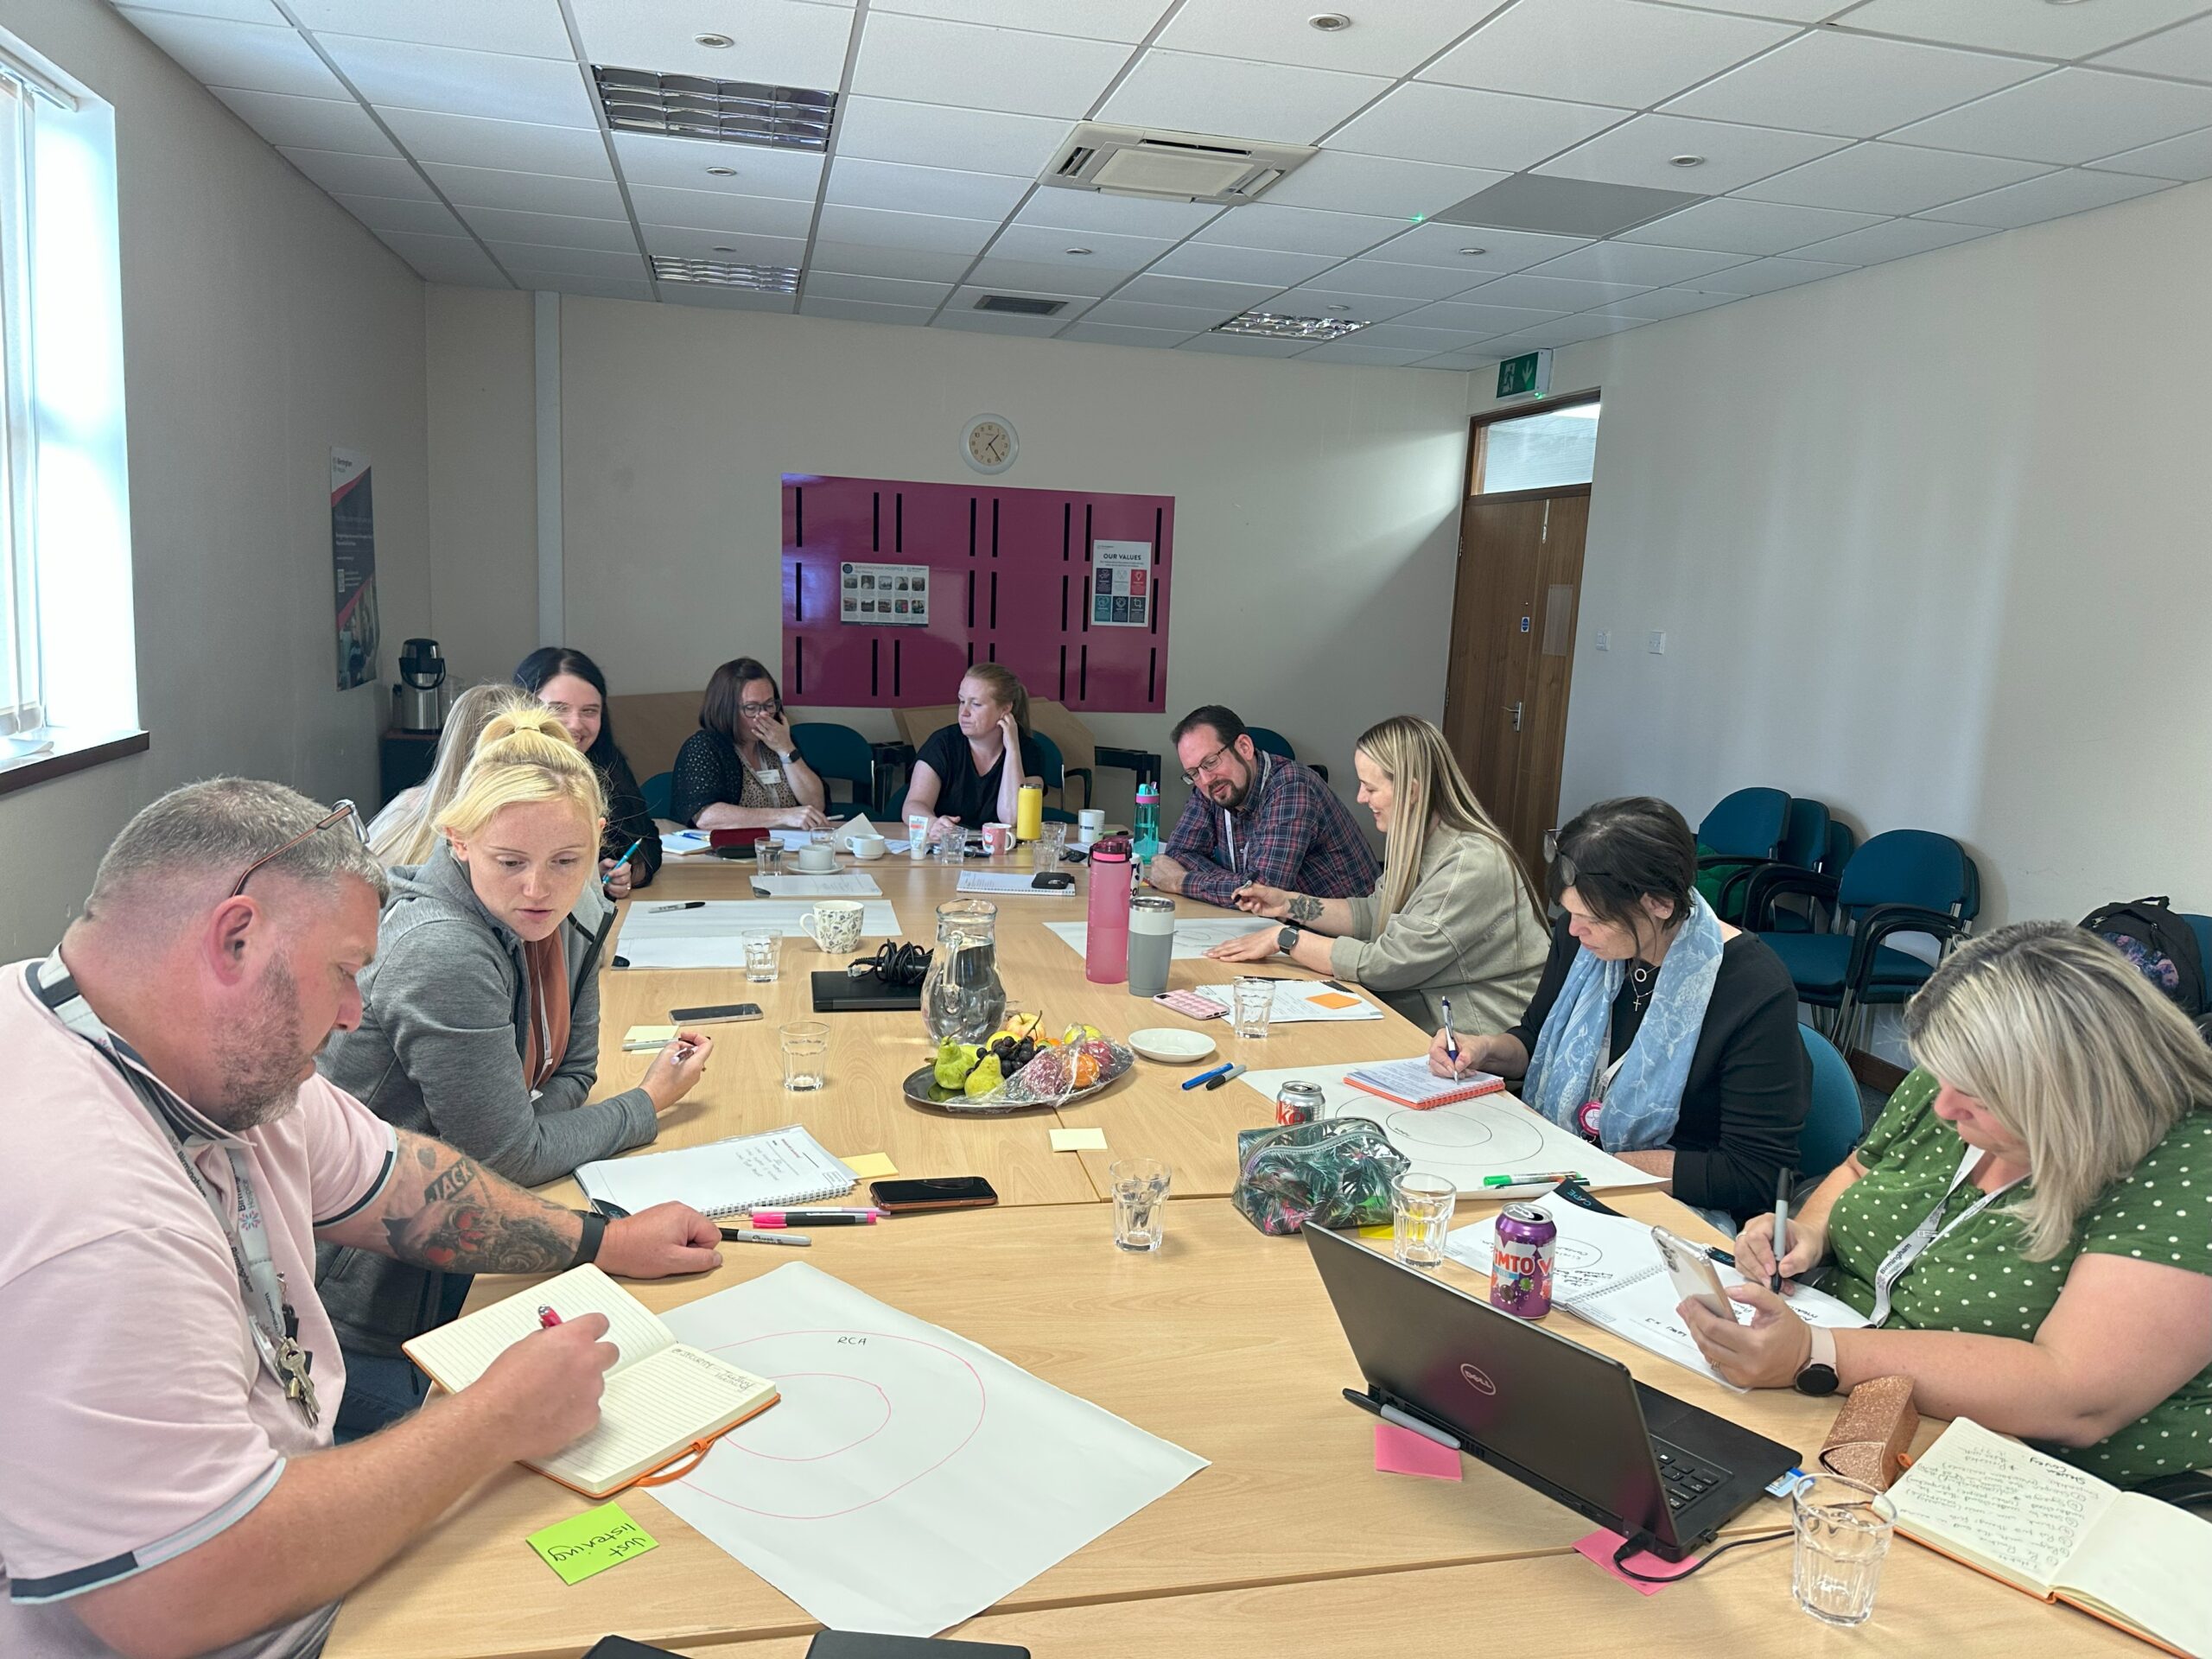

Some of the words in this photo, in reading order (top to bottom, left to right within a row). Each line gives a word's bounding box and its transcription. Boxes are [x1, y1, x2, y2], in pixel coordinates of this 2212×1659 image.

[428, 1160, 474, 1204] JACK
[231, 1246, 254, 1293] Birmingham
[1879, 1243, 1912, 1274] Birmingham
[1464, 1370, 1493, 1389] DELL
[547, 1522, 637, 1562] listening
[608, 1536, 646, 1557] Just
